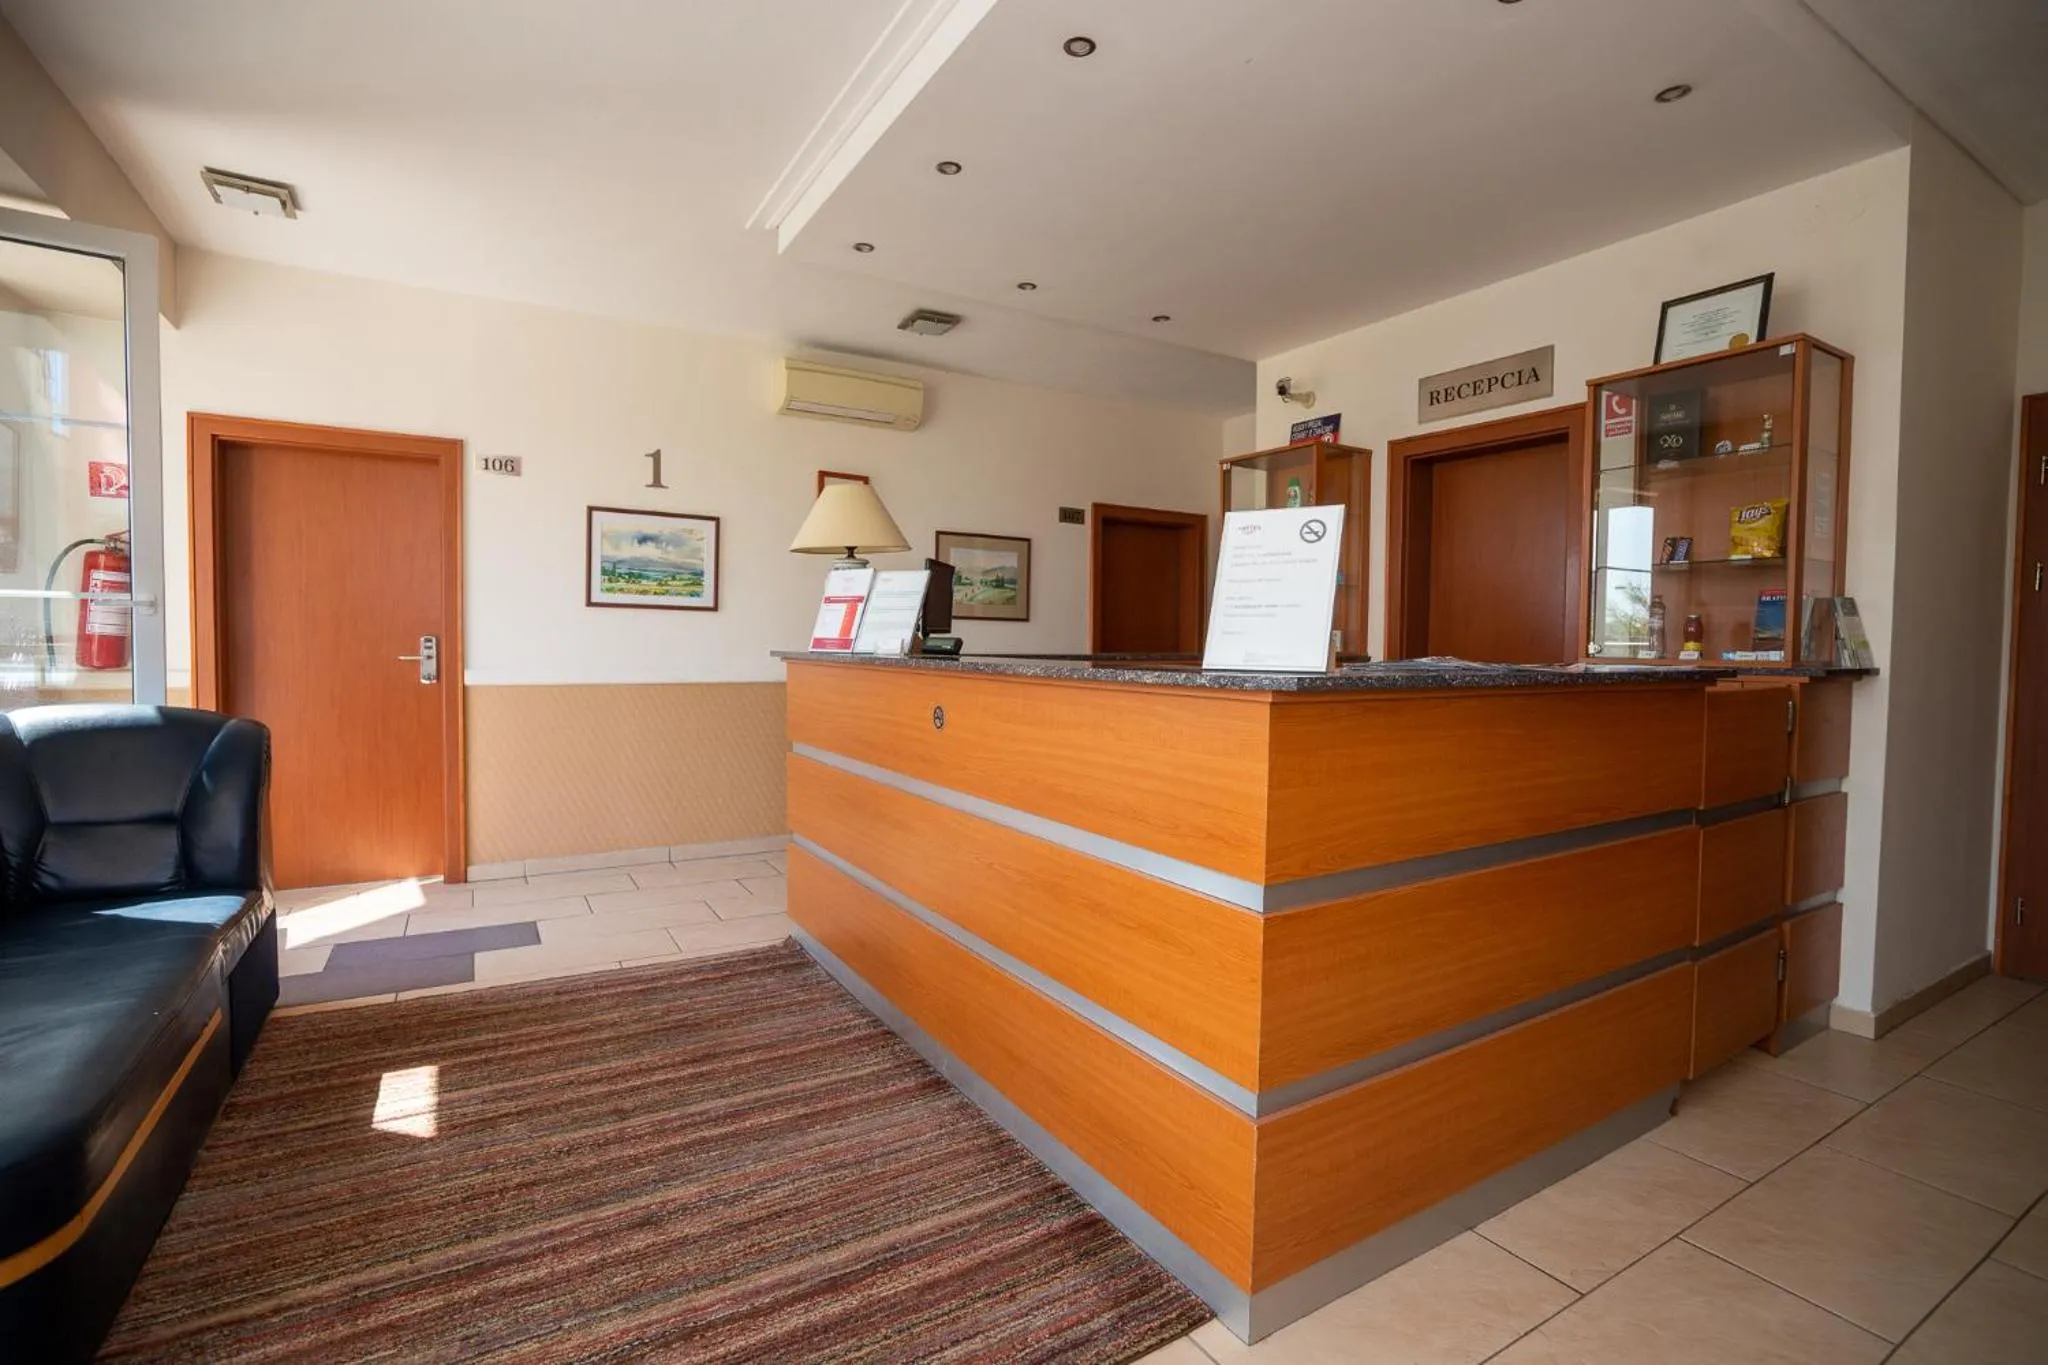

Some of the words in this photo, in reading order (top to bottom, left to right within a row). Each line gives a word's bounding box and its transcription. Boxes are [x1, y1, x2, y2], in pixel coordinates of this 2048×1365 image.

[1428, 367, 1541, 406] RECEPCIA
[482, 457, 515, 473] 106
[644, 449, 669, 489] 1
